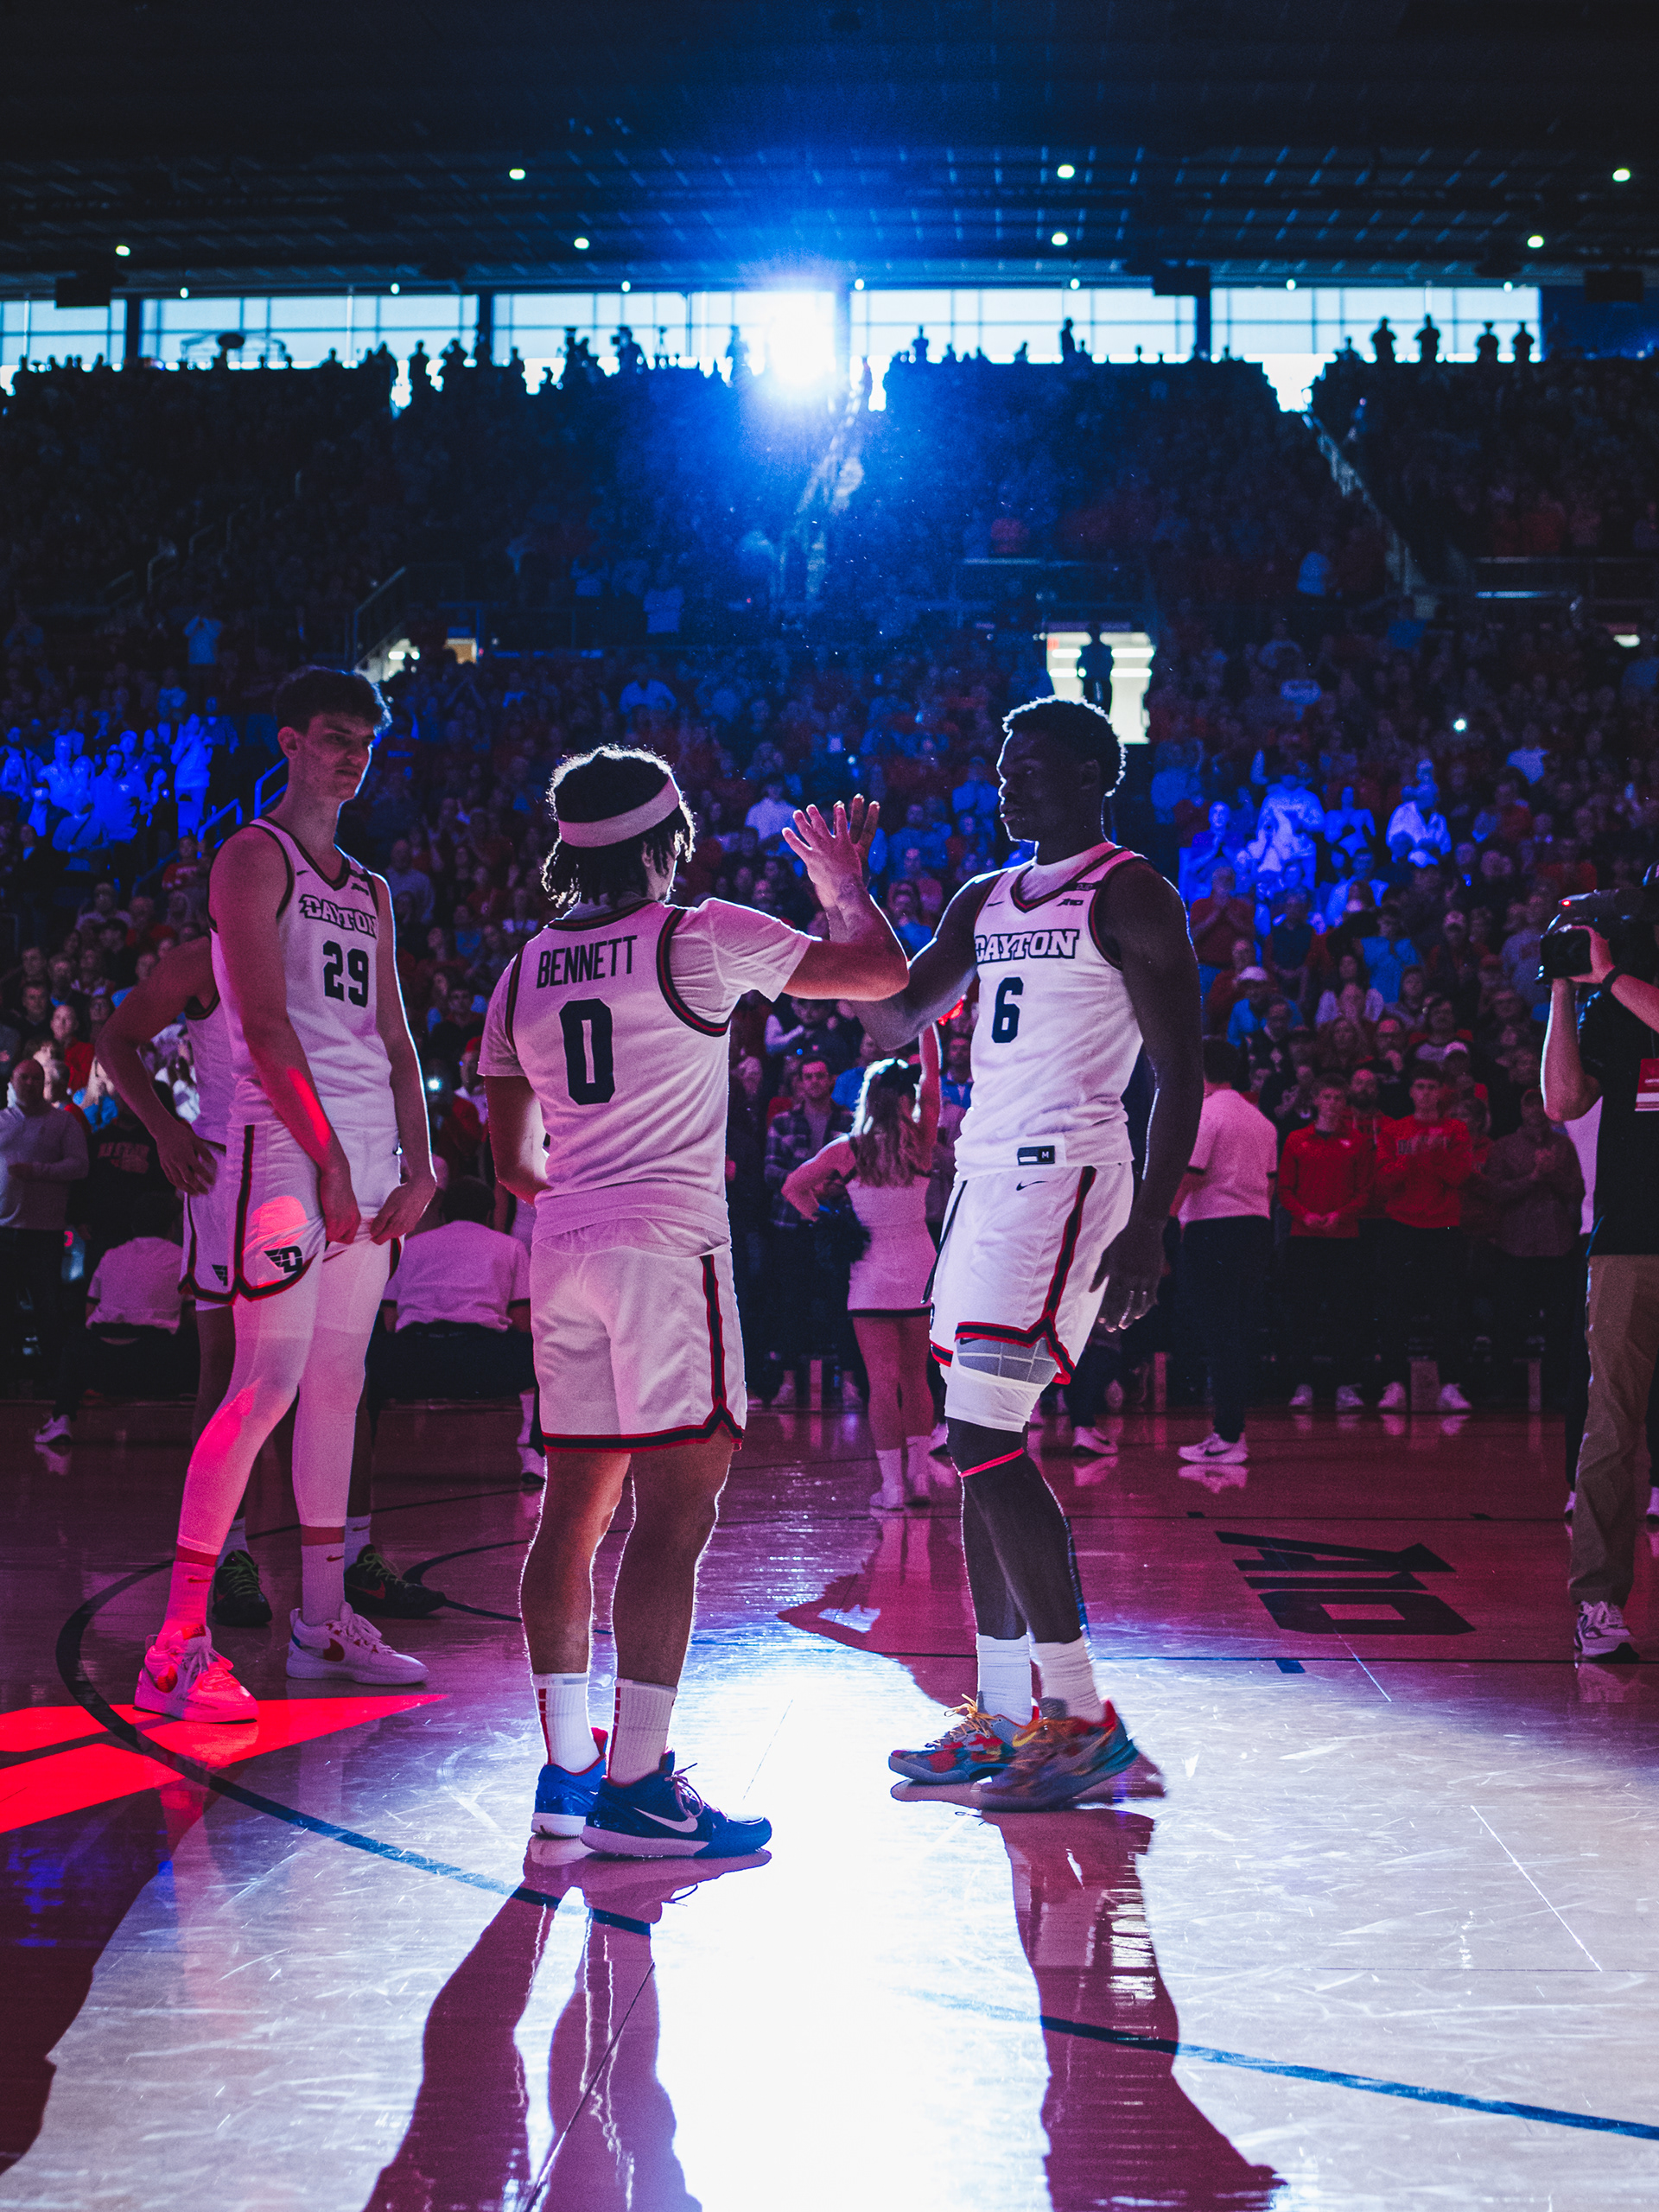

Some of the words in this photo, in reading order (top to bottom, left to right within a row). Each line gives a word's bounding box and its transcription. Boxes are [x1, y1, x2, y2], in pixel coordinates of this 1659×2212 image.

[299, 893, 377, 939] DAYTON
[322, 940, 369, 1007] 29
[537, 935, 638, 988] BENNETT
[975, 928, 1080, 965] DAYTON
[991, 976, 1024, 1044] 6
[559, 998, 616, 1105] 0
